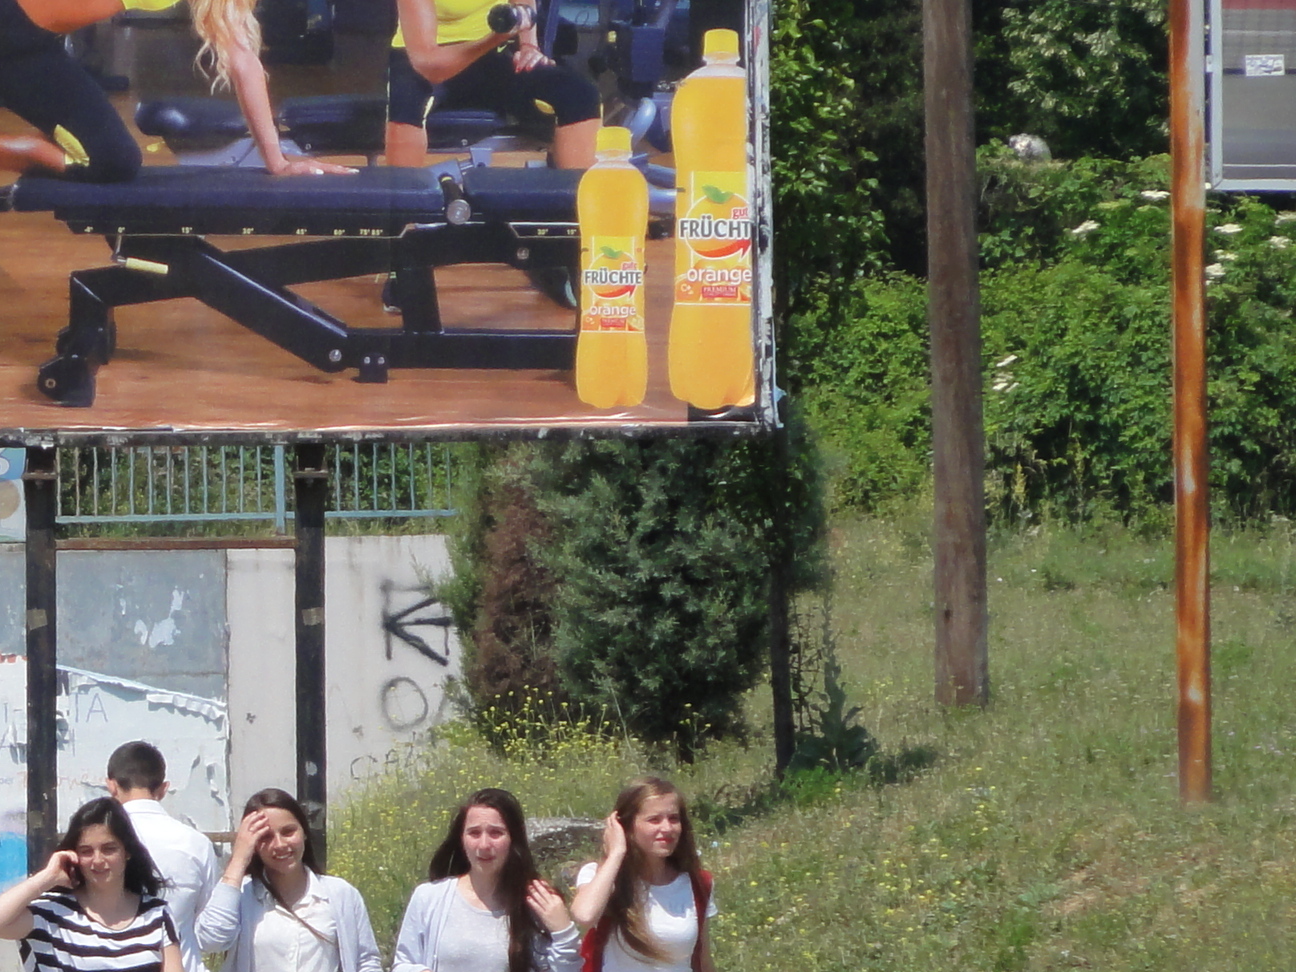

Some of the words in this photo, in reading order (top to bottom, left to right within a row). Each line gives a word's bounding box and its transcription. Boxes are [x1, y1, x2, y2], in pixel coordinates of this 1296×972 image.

[584, 267, 642, 284] FRÜCHTE
[686, 267, 753, 285] orange
[589, 304, 636, 318] orange
